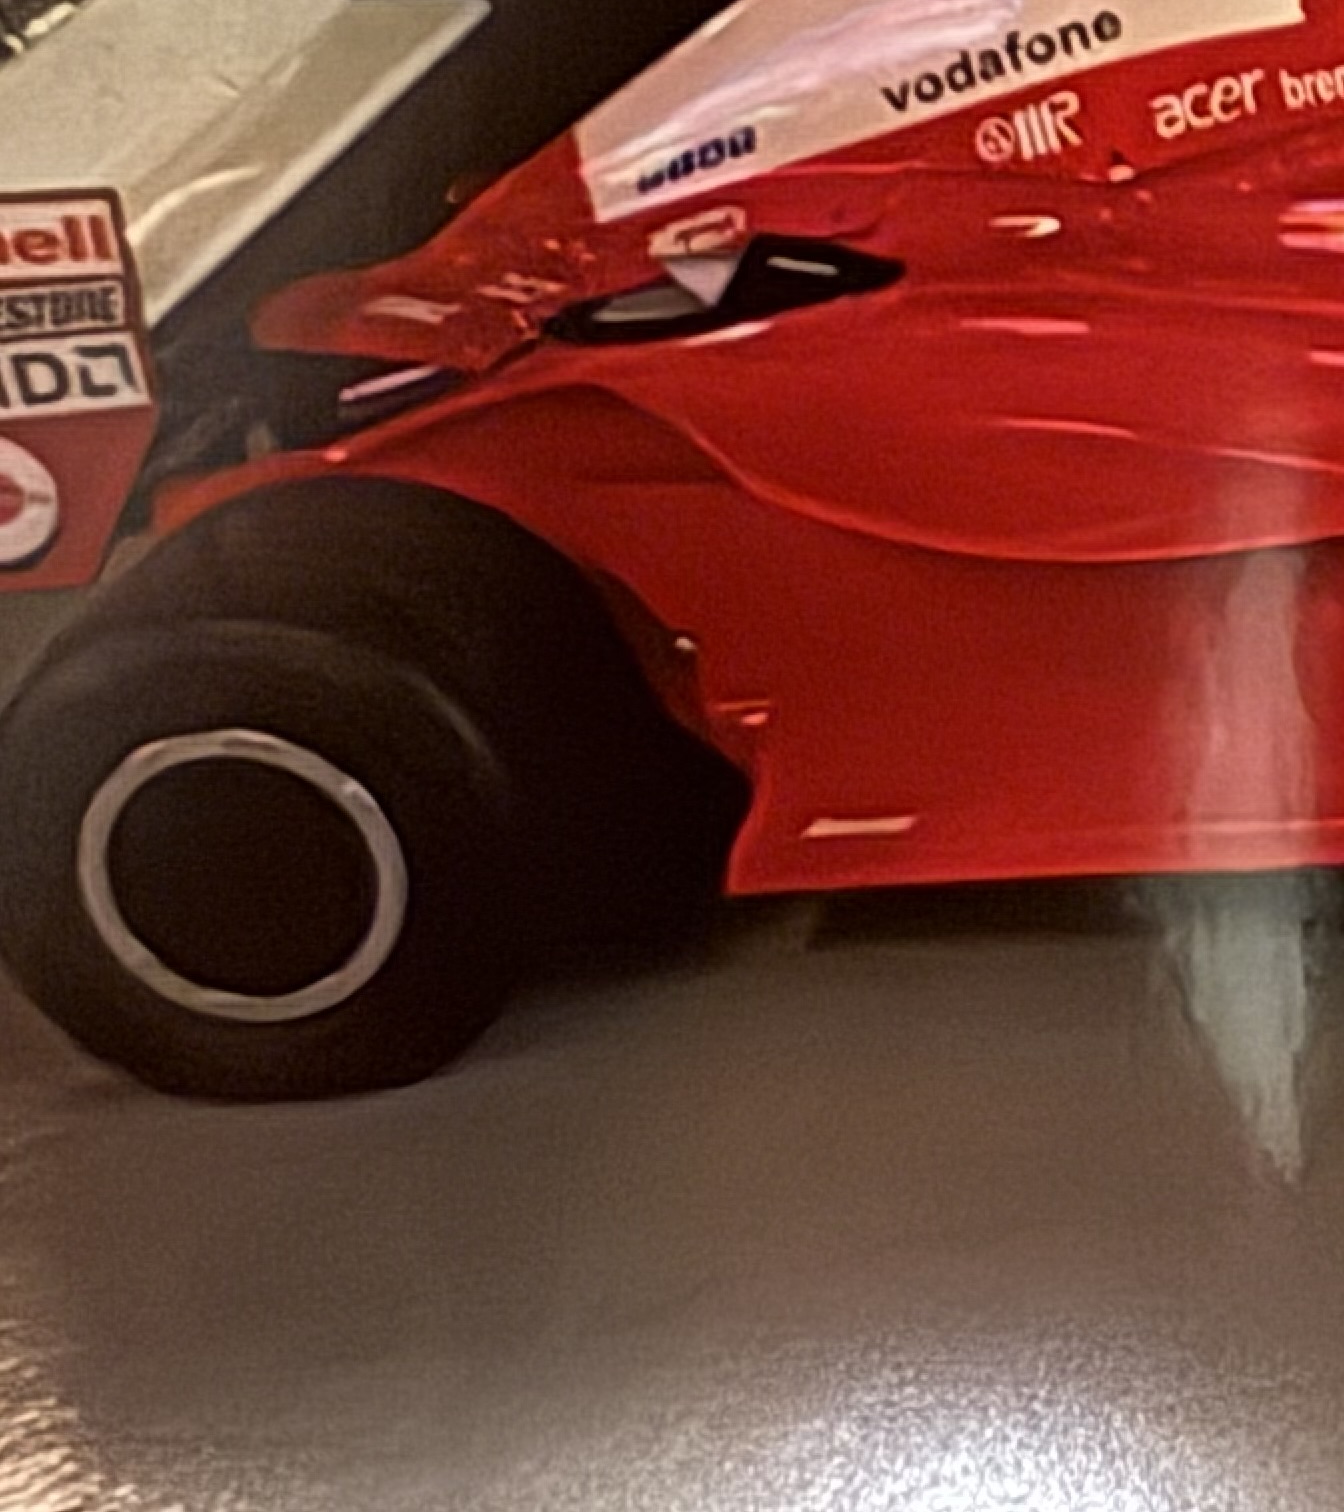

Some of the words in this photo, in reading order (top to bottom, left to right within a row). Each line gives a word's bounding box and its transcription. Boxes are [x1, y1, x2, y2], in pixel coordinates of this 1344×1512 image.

[880, 10, 1122, 113] vodafone
[1149, 68, 1265, 139] acer
[0, 286, 119, 330] STONE
